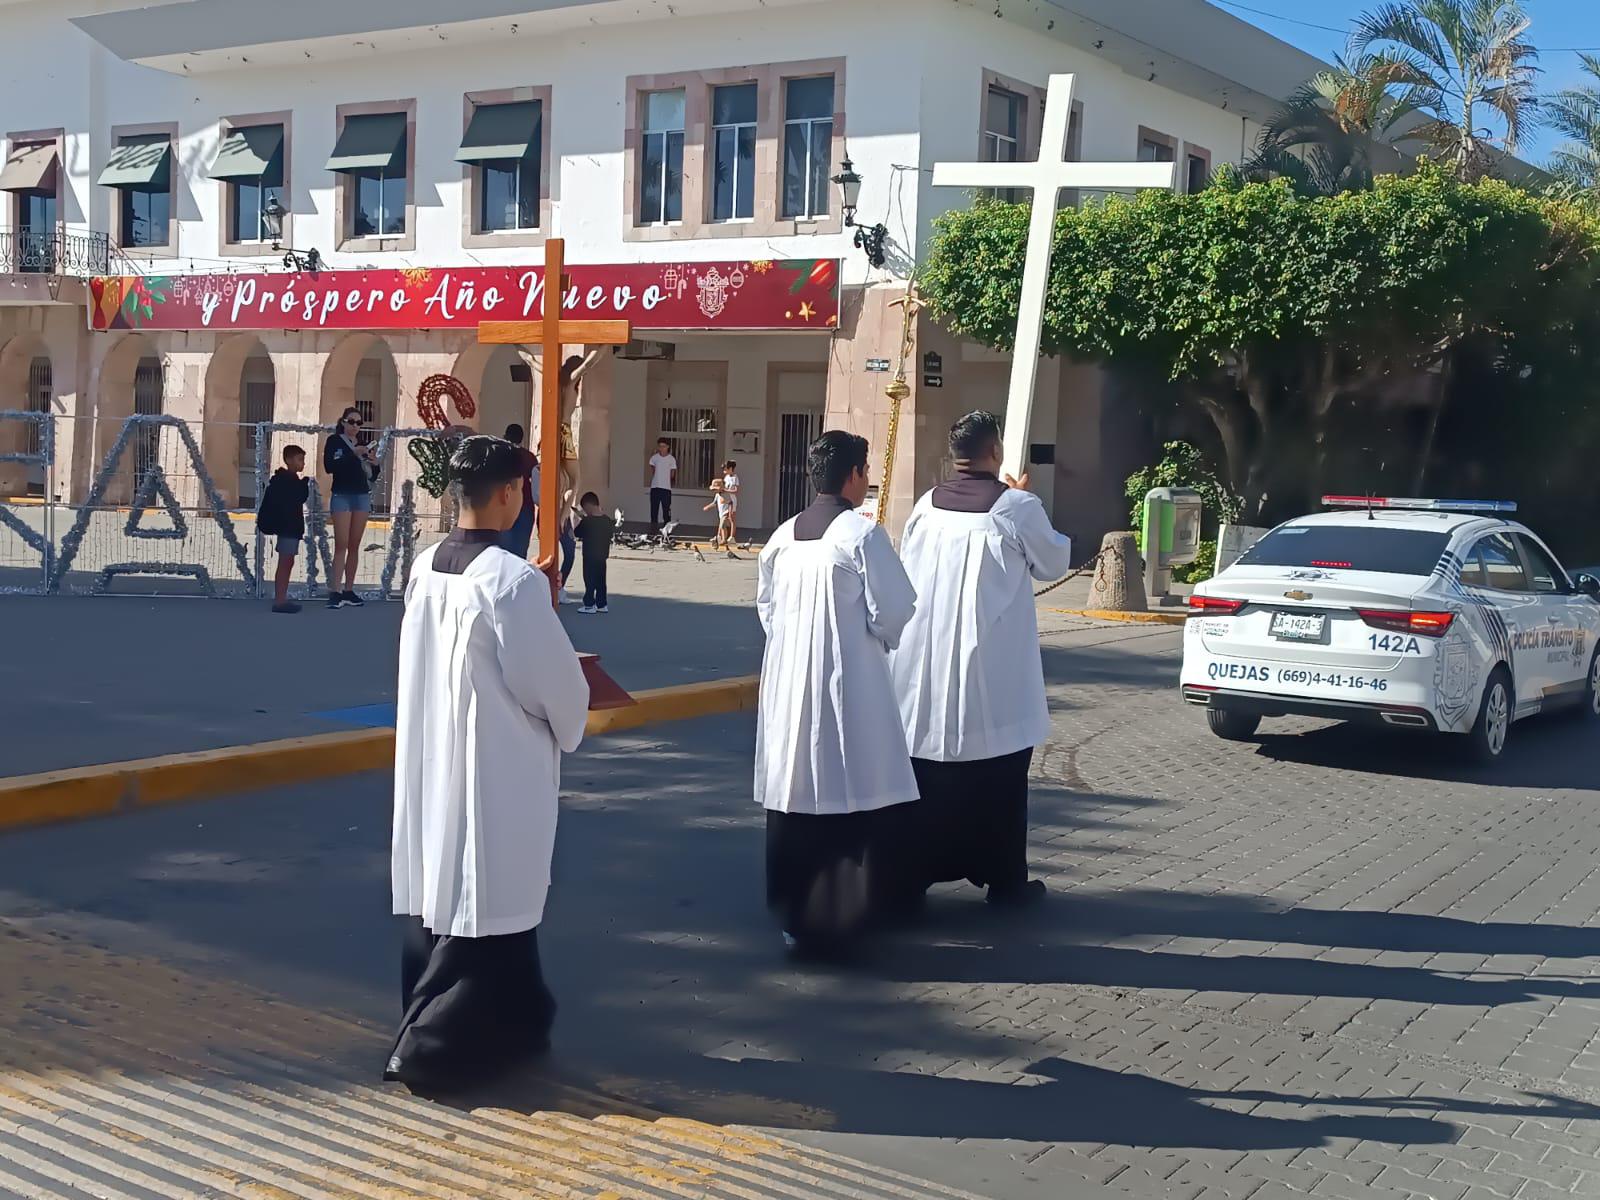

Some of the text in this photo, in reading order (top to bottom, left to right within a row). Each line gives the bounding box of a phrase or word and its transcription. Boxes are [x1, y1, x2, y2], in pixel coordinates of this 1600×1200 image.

[202, 292, 221, 326] y
[231, 278, 411, 326] Próspero
[424, 273, 504, 320] Año
[1368, 634, 1421, 654] 142A
[1208, 662, 1388, 691] QUEJAS (669)4-41-16-46
